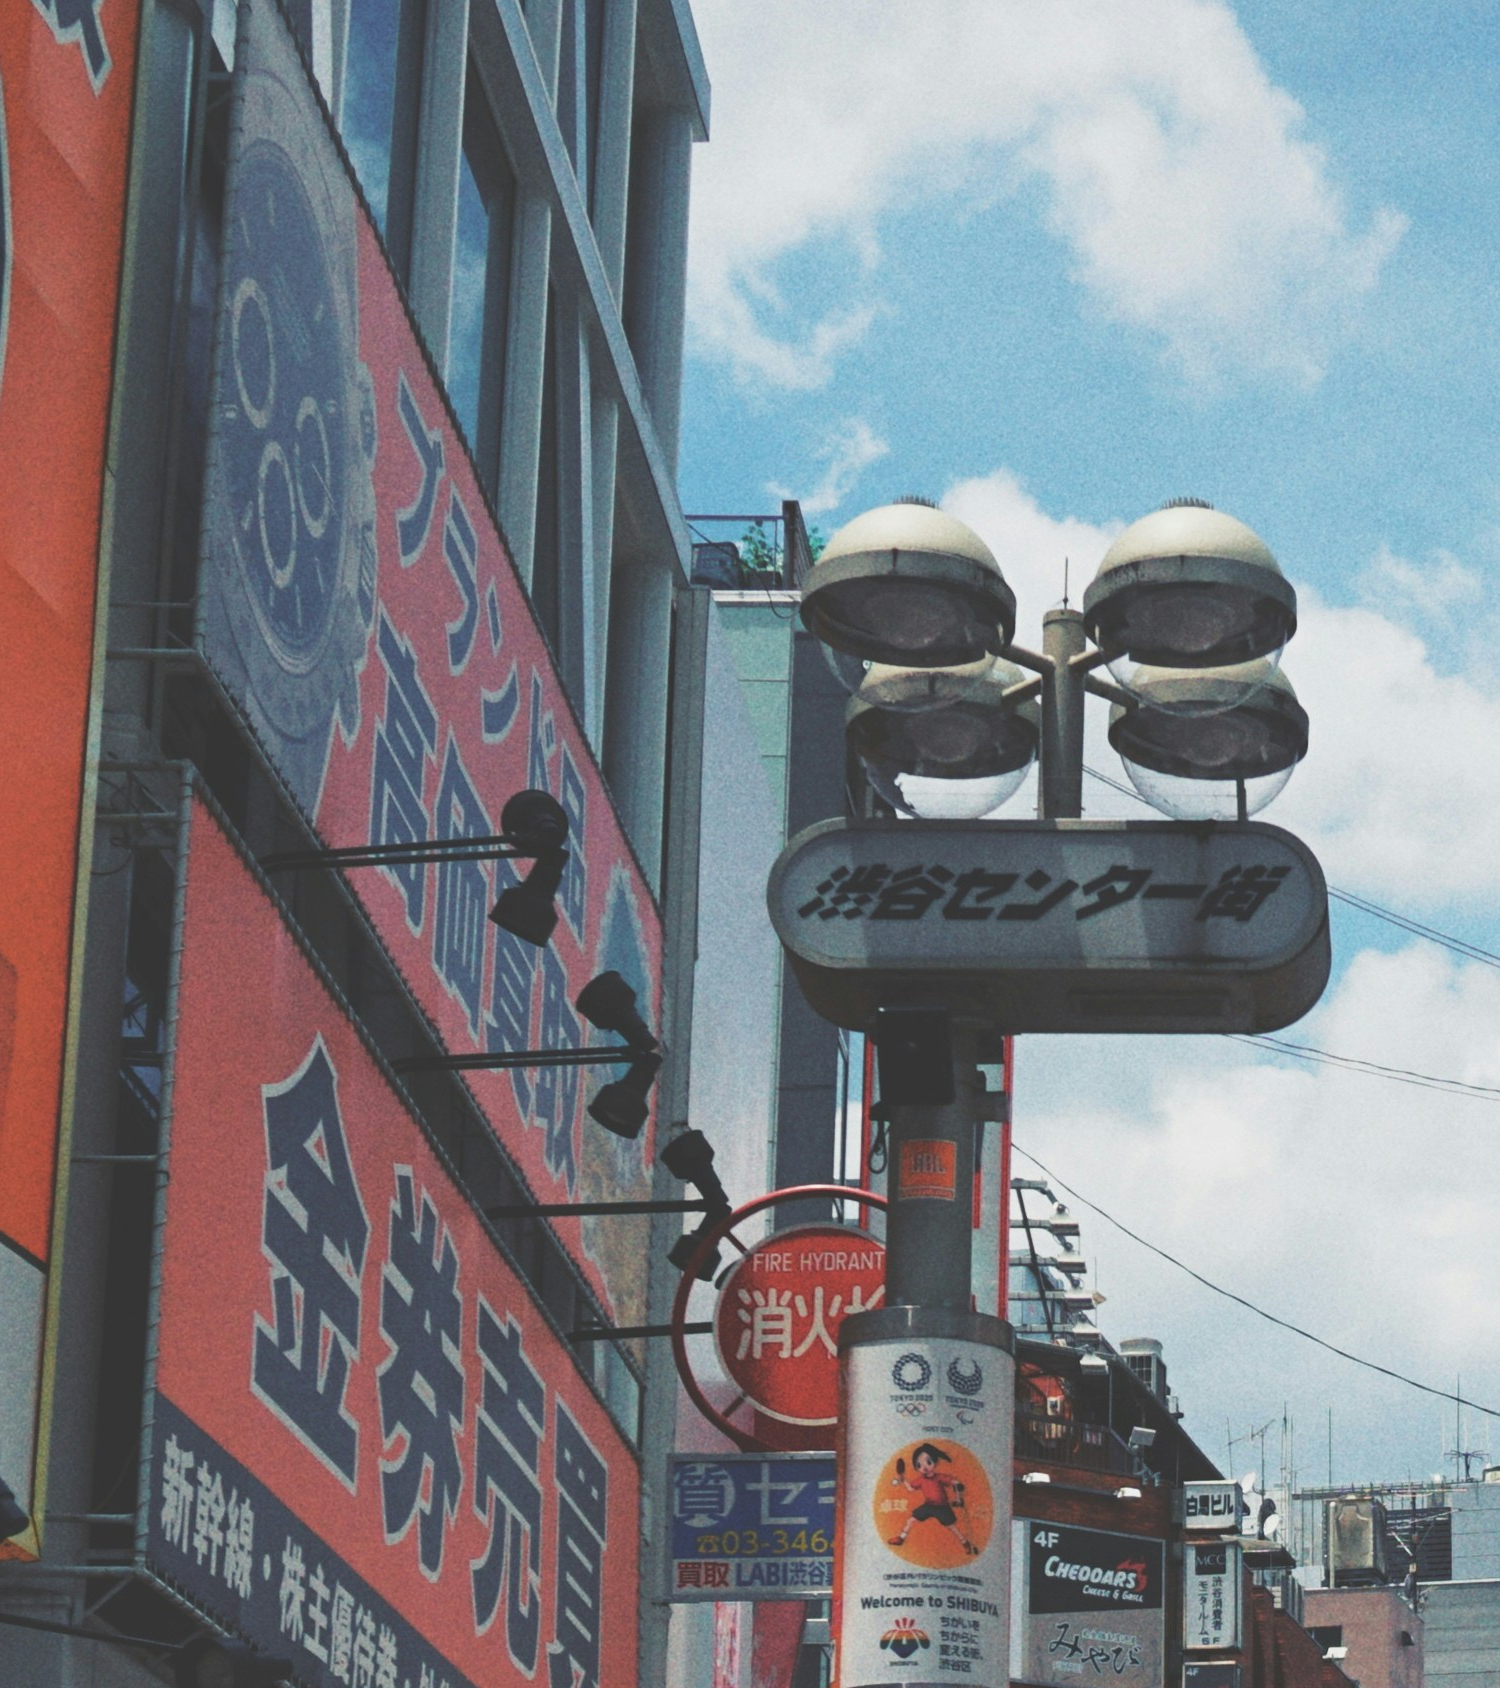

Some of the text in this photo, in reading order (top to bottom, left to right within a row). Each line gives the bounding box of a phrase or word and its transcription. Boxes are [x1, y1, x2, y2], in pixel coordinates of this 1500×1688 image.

[797, 862, 1294, 922] 渋谷センター街
[753, 1250, 886, 1273] FIRE HYDRANT
[1034, 1530, 1059, 1549] 4F
[1197, 1552, 1226, 1567] MCC
[677, 1559, 729, 1589] 買取
[861, 1595, 999, 1619] Welcome to SHIBUYA
[1197, 1580, 1210, 1637] モニタールーム
[1211, 1576, 1224, 1632] 渋谷消費者
[939, 1615, 980, 1632] ちがいを
[939, 1630, 979, 1645] ちからに
[1049, 1623, 1143, 1676] みやび
[938, 1658, 973, 1674] 渋谷区
[1186, 1667, 1198, 1677] 4F
